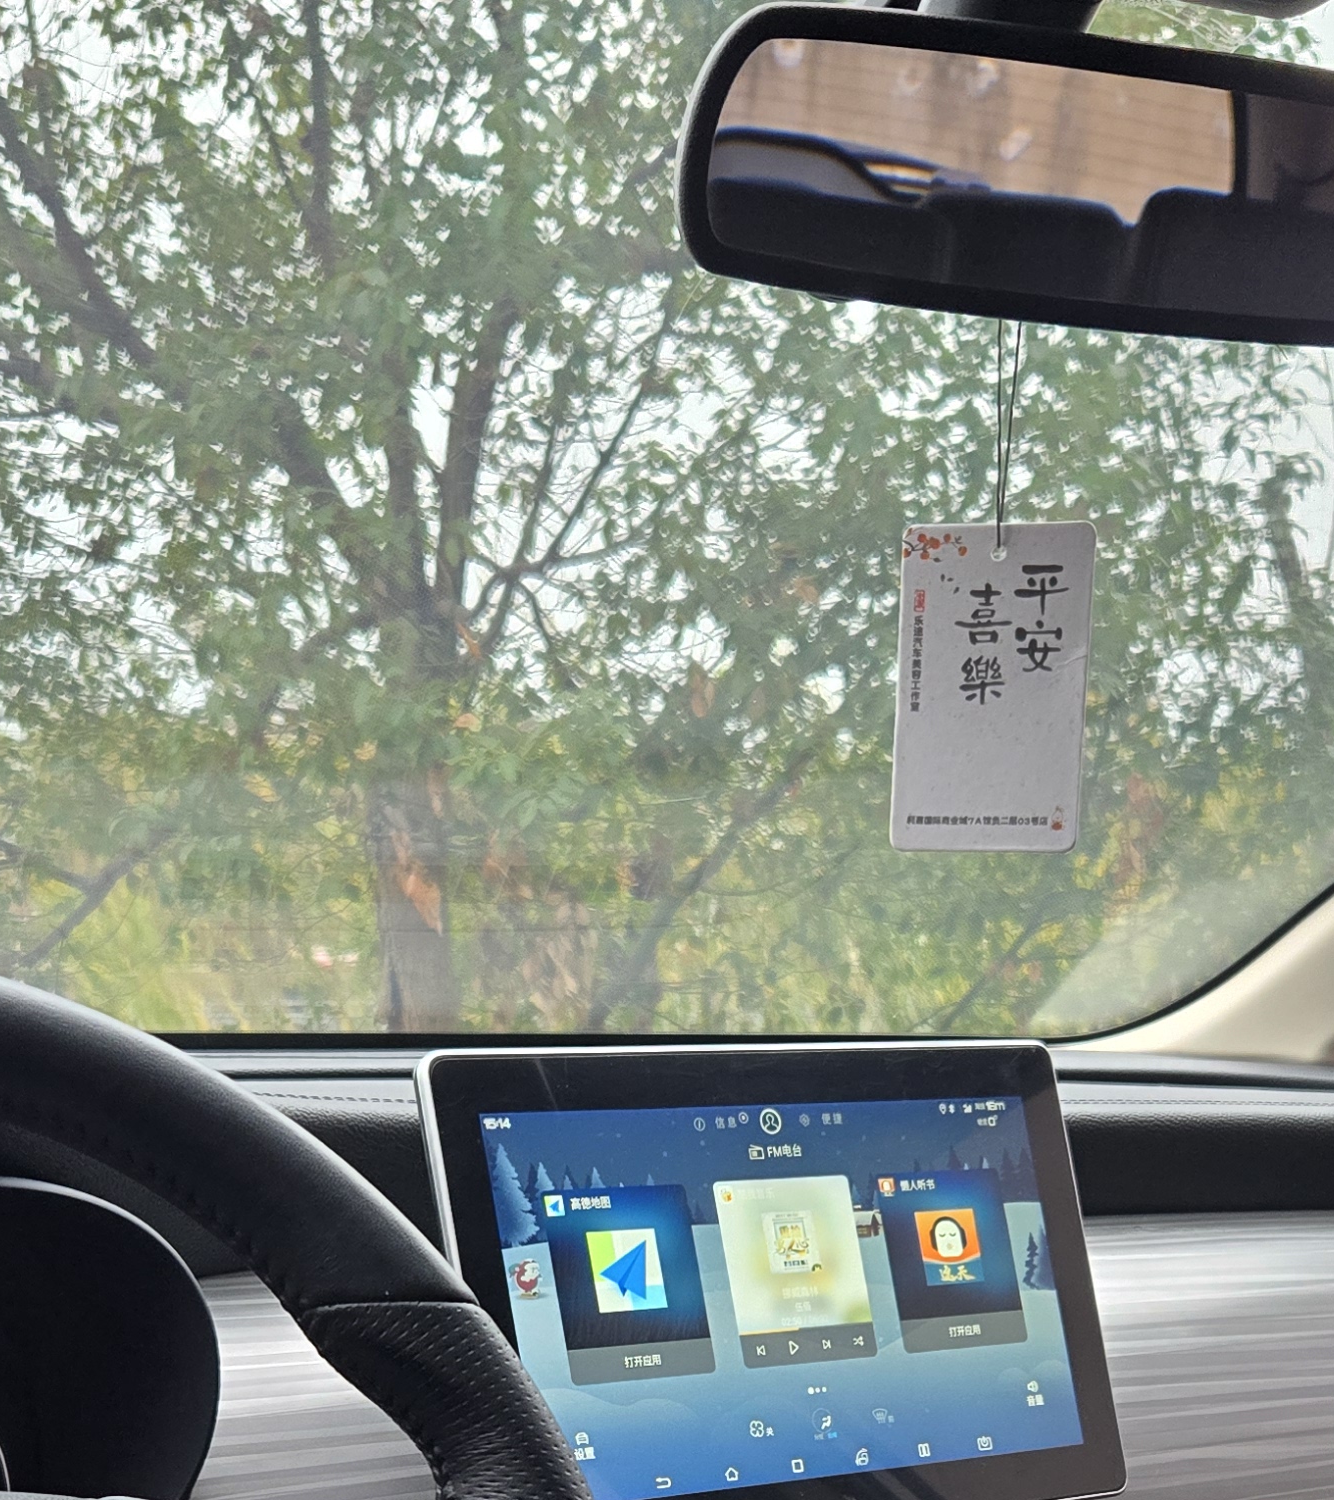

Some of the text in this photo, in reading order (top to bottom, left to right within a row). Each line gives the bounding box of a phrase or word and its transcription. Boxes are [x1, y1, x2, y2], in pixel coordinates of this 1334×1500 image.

[1013, 563, 1069, 673] 平安
[954, 582, 1013, 705] 喜樂
[715, 1116, 737, 1129] 信息
[767, 1143, 802, 1157] FM电台
[570, 1195, 612, 1211] 高德地图
[948, 1325, 981, 1337] 打开应用
[624, 1354, 662, 1369] 打开应用
[1026, 1394, 1044, 1406] 音量
[574, 1447, 595, 1460] 设置
